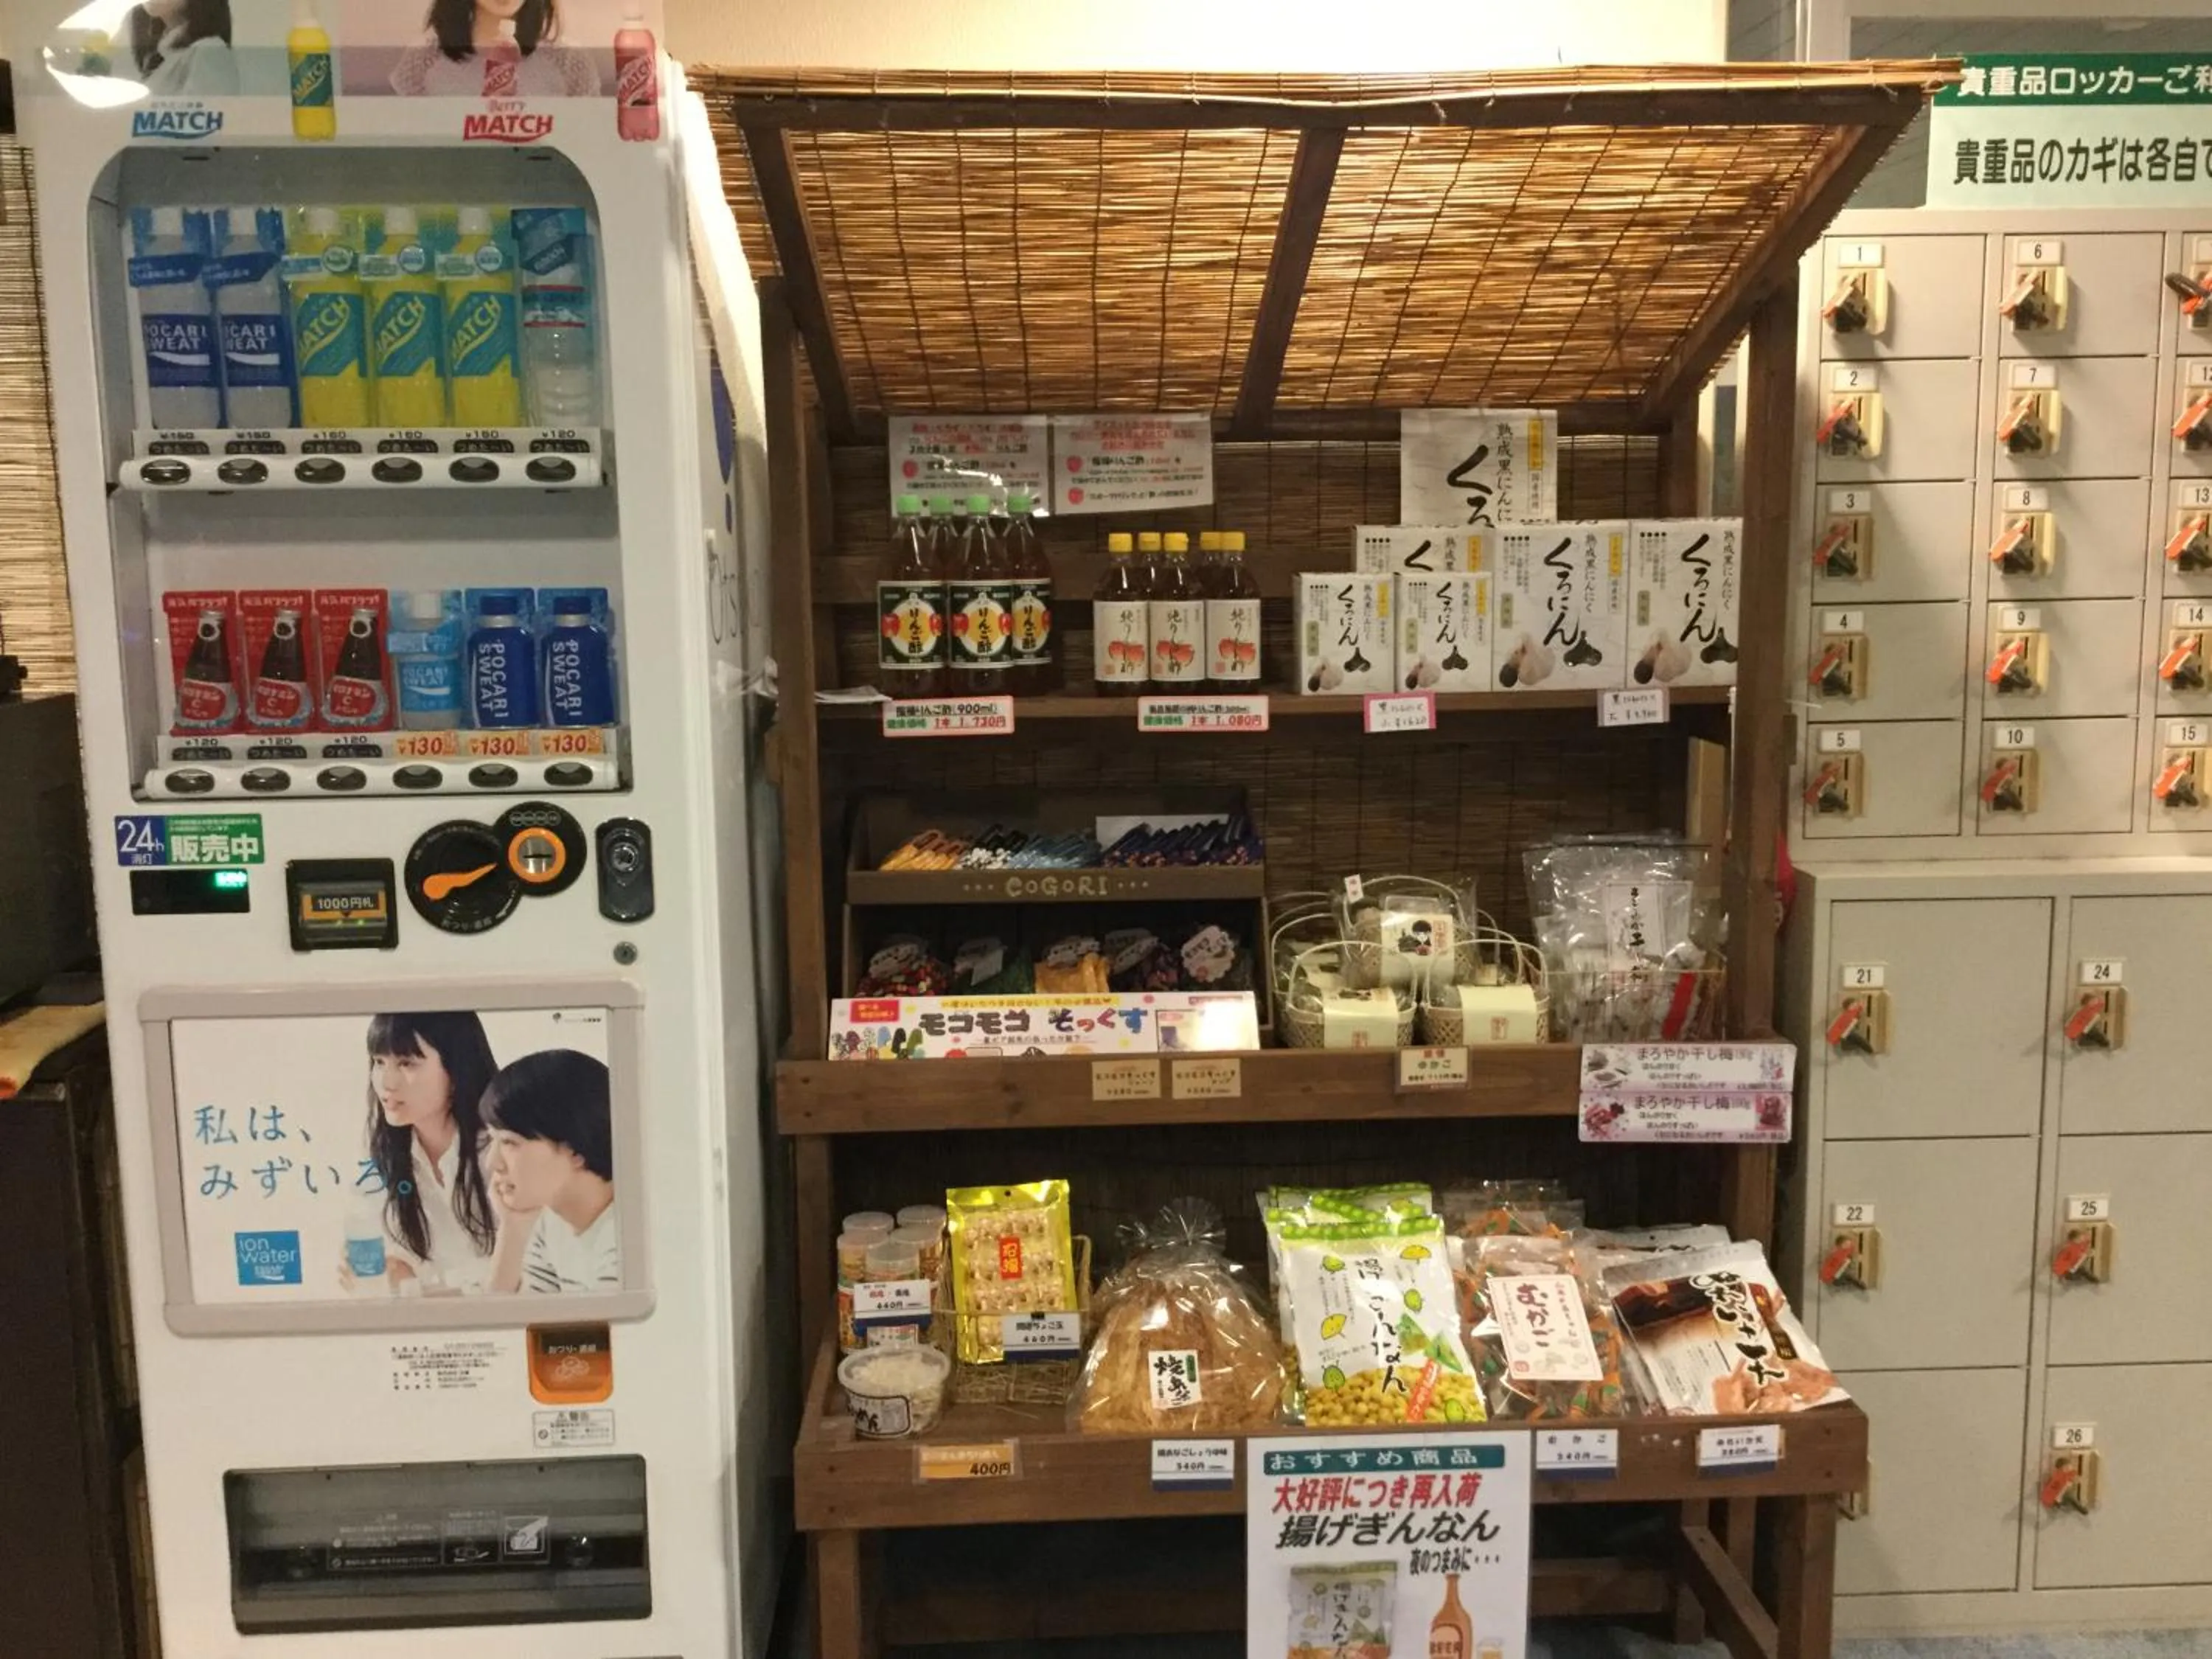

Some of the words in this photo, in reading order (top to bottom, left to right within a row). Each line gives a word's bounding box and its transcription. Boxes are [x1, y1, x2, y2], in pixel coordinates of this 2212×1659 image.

[133, 111, 223, 139] MATCH
[463, 114, 554, 142] MATCH
[1857, 247, 1863, 260] 1
[2034, 243, 2043, 260] 6
[1850, 371, 1858, 386] 2
[2029, 367, 2037, 382] 7
[1846, 493, 1854, 509] 3
[2023, 490, 2031, 506] 8
[2196, 487, 2210, 503] 13
[1543, 537, 1580, 646] くろにん
[1680, 533, 1717, 642] くろにん
[1840, 614, 1848, 628] 4
[2017, 611, 2025, 626] 9
[2190, 607, 2203, 622] 14
[478, 642, 493, 710] SWEAT
[490, 639, 509, 718] POCARI
[552, 641, 568, 709] SWEAT
[564, 639, 582, 717] POCARI
[1837, 732, 1845, 748] 5
[2008, 729, 2023, 744] 10
[2182, 725, 2196, 741] 15
[117, 819, 165, 852] 24h
[170, 834, 260, 863] 販売中
[317, 897, 374, 909] 1000円札
[1857, 968, 1871, 984] 21
[2094, 964, 2110, 980] 24
[918, 1008, 1031, 1036] モコモコ
[1048, 1007, 1148, 1034] そっくす
[195, 1104, 312, 1145] 私は、
[199, 1158, 413, 1200] みずいろ。
[1846, 1206, 1863, 1222] 22
[2081, 1200, 2097, 1217] 25
[239, 1237, 270, 1252] ion
[240, 1249, 298, 1264] water
[2065, 1429, 2082, 1444] 26
[1269, 1447, 1478, 1471] おすすめ商品
[969, 1461, 1012, 1475] 400円
[1272, 1472, 1483, 1514] 大好評につき再入荷
[1276, 1509, 1501, 1550] 揚げぎんなん
[1429, 1641, 1463, 1653] BEER
